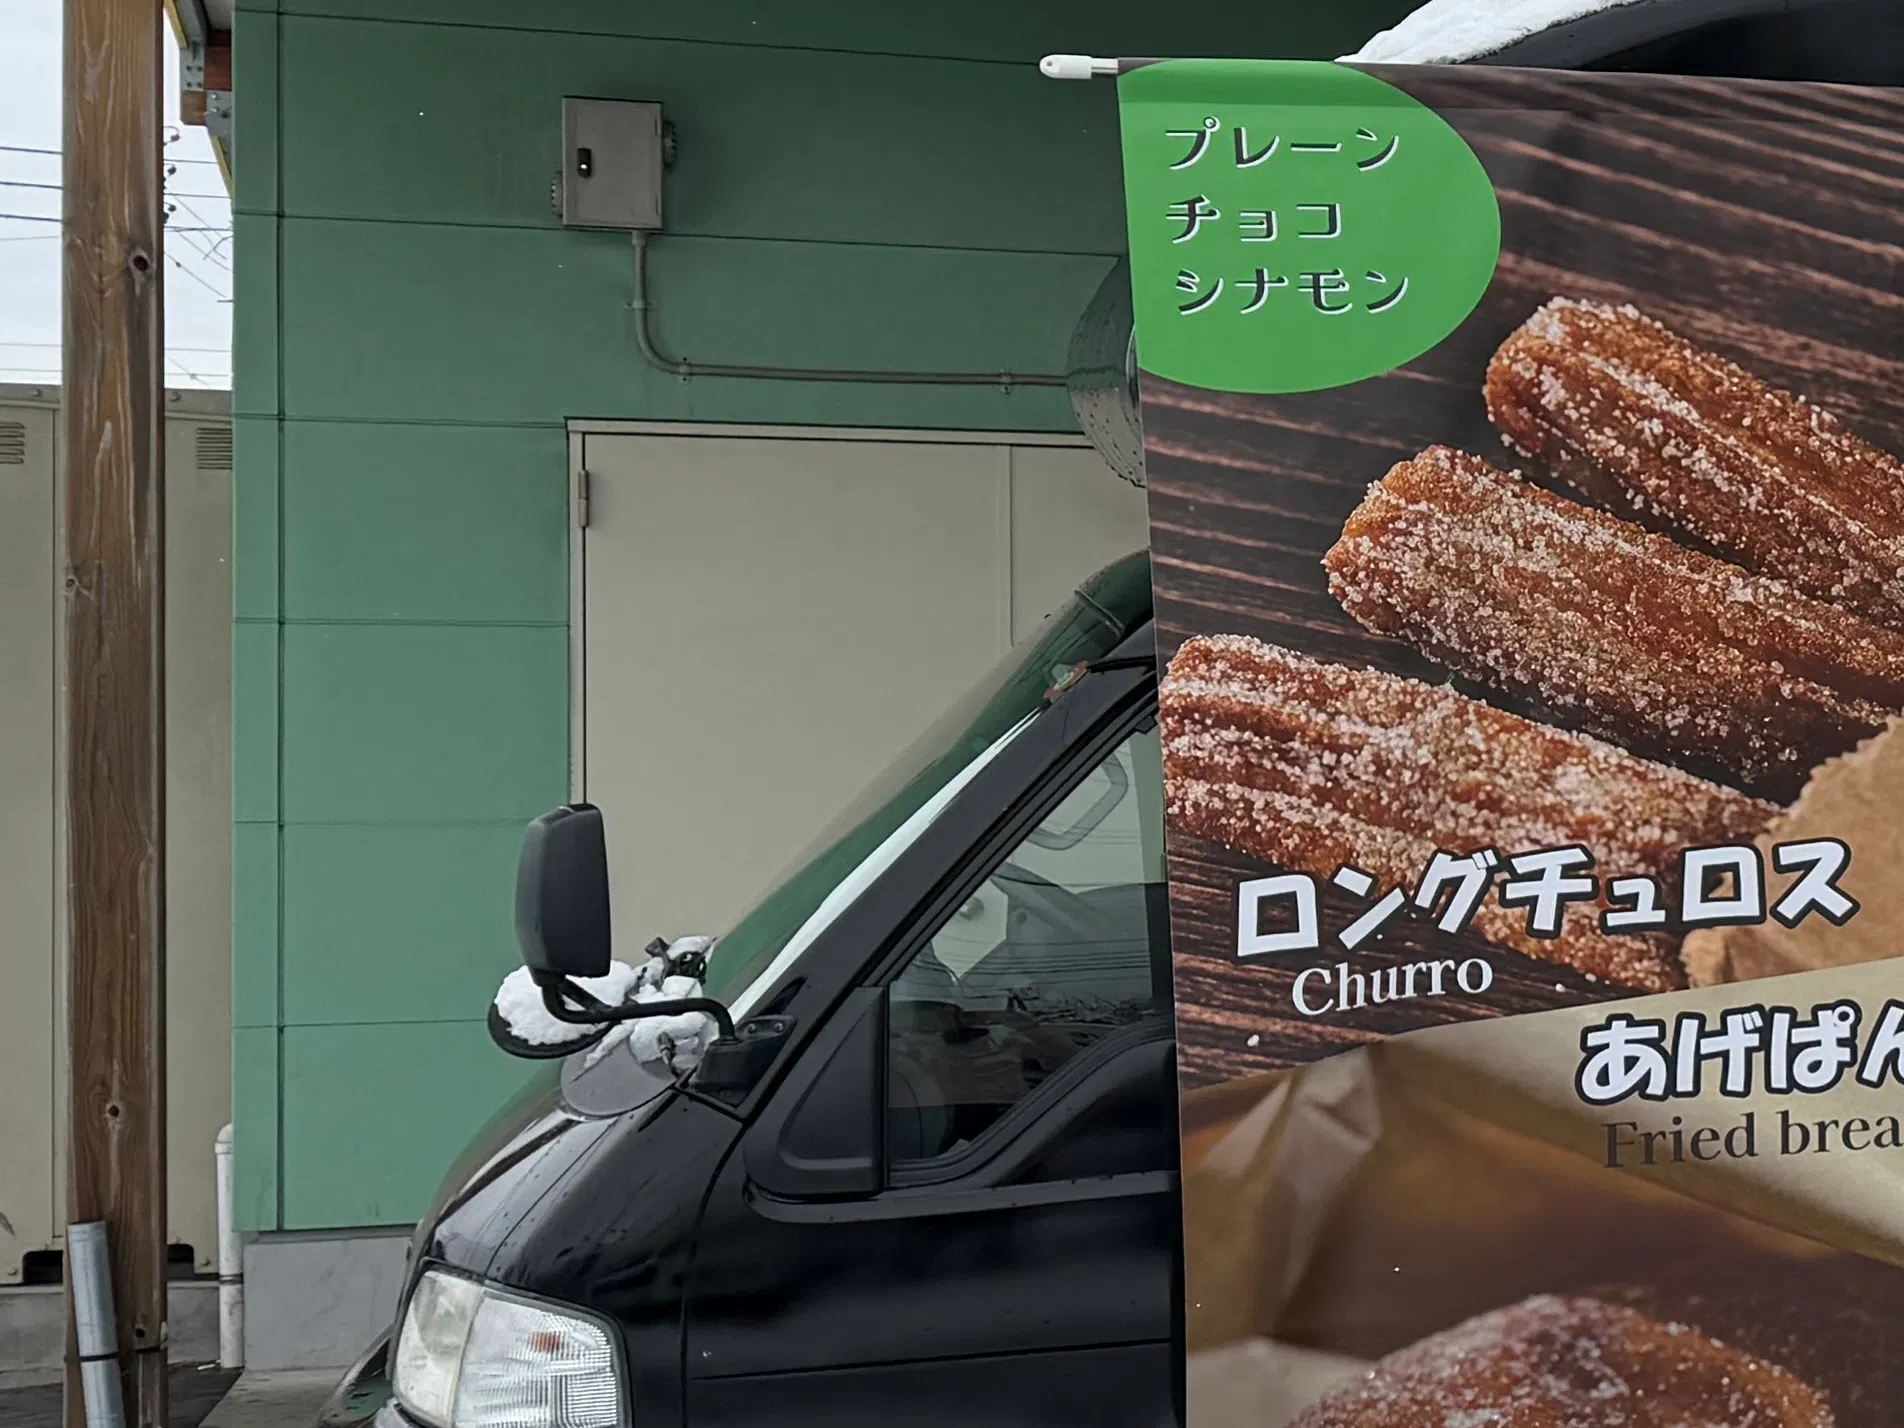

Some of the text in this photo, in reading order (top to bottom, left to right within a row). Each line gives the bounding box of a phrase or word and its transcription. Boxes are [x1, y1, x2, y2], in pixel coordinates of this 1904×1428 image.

[1165, 115, 1401, 171] プレーン
[1165, 195, 1343, 245] チョコ
[1174, 266, 1412, 317] シナモン
[1235, 836, 1861, 959] ロングチュロス
[1291, 955, 1494, 1018] Churro
[1601, 1112, 1757, 1170] Fried
